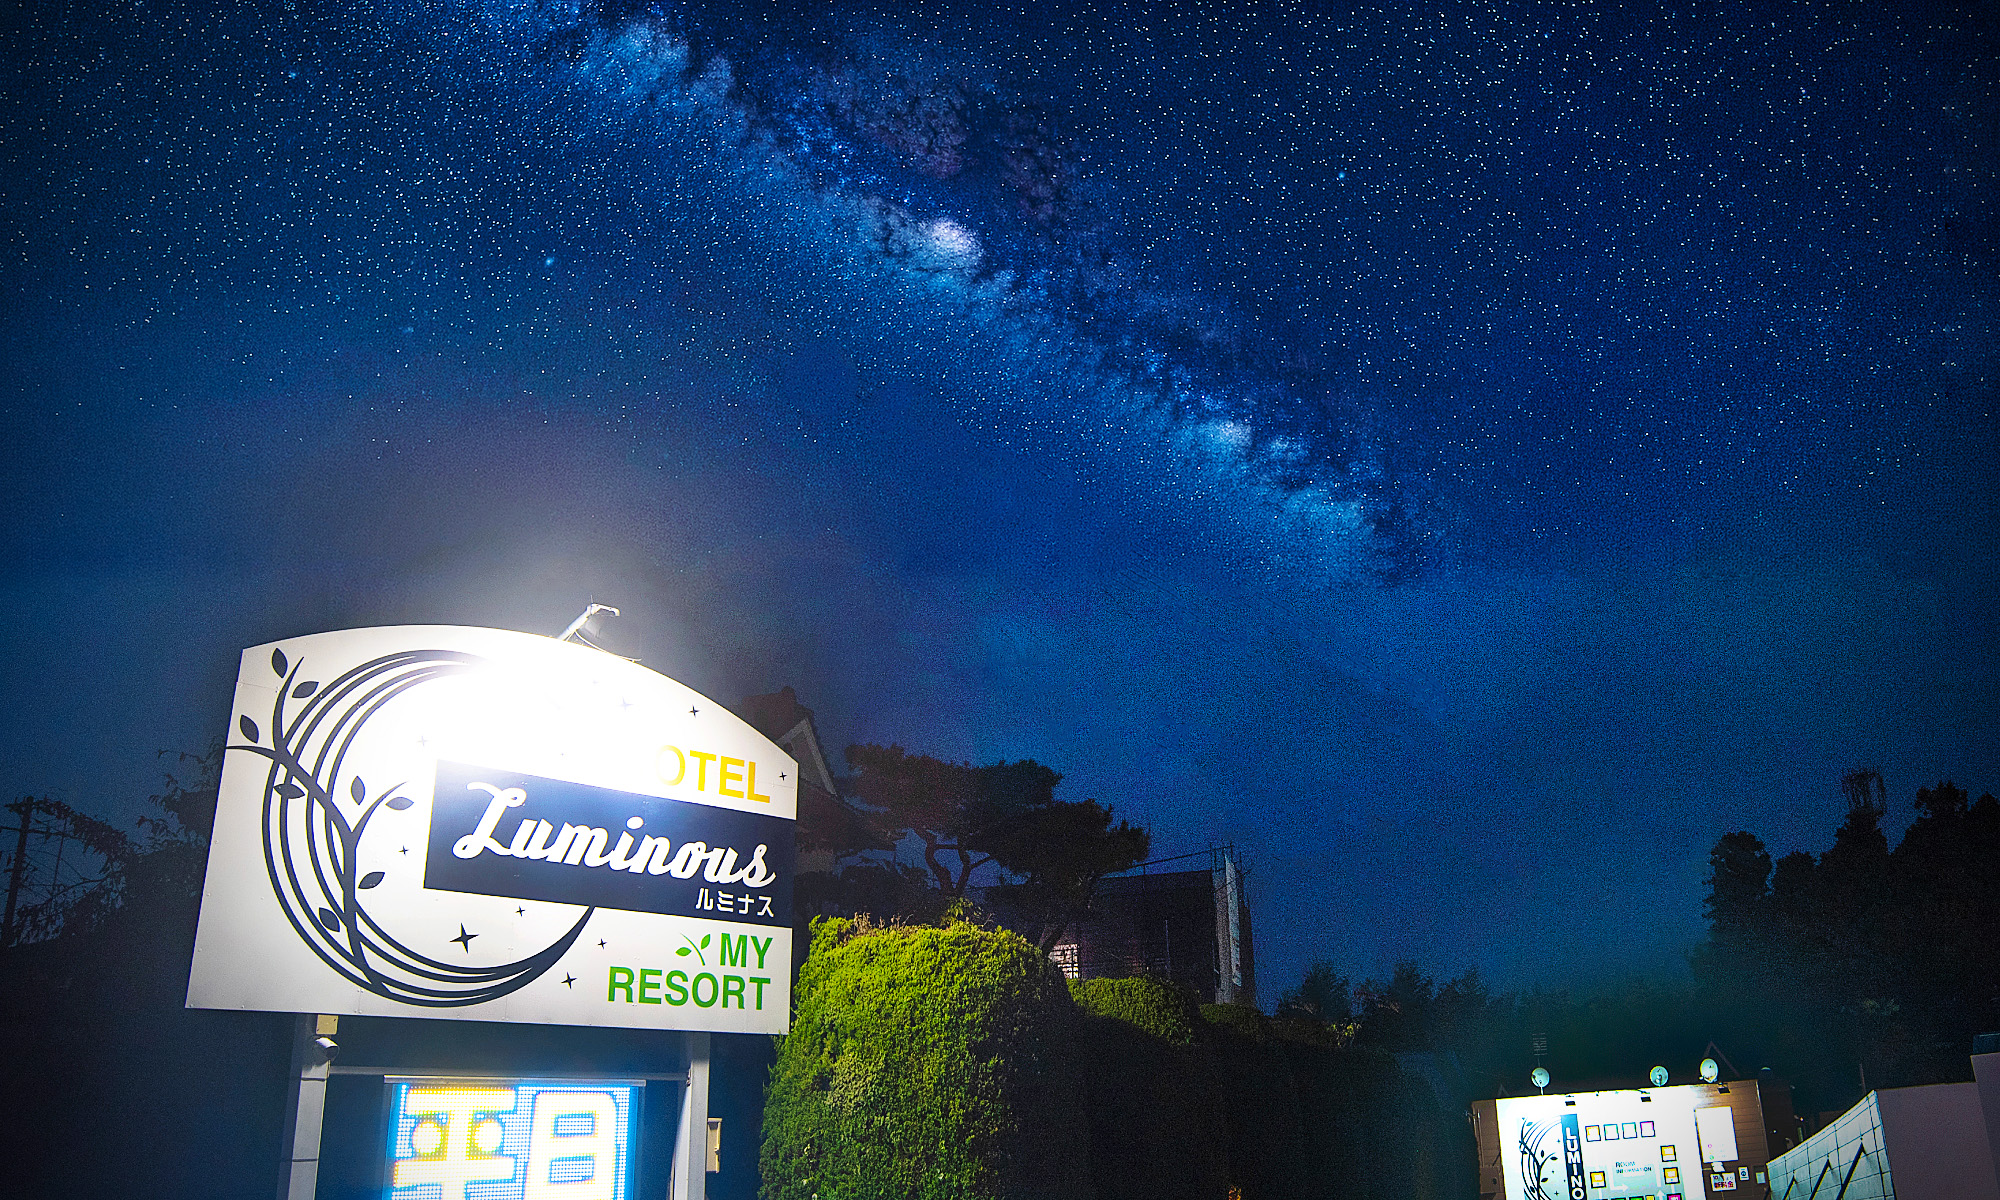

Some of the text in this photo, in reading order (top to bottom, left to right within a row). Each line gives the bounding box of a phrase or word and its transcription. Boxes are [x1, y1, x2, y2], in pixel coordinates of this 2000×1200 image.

[452, 781, 777, 887] Luminous
[695, 888, 774, 917] ルミナス
[720, 933, 773, 969] MY
[607, 966, 771, 1010] RESORT
